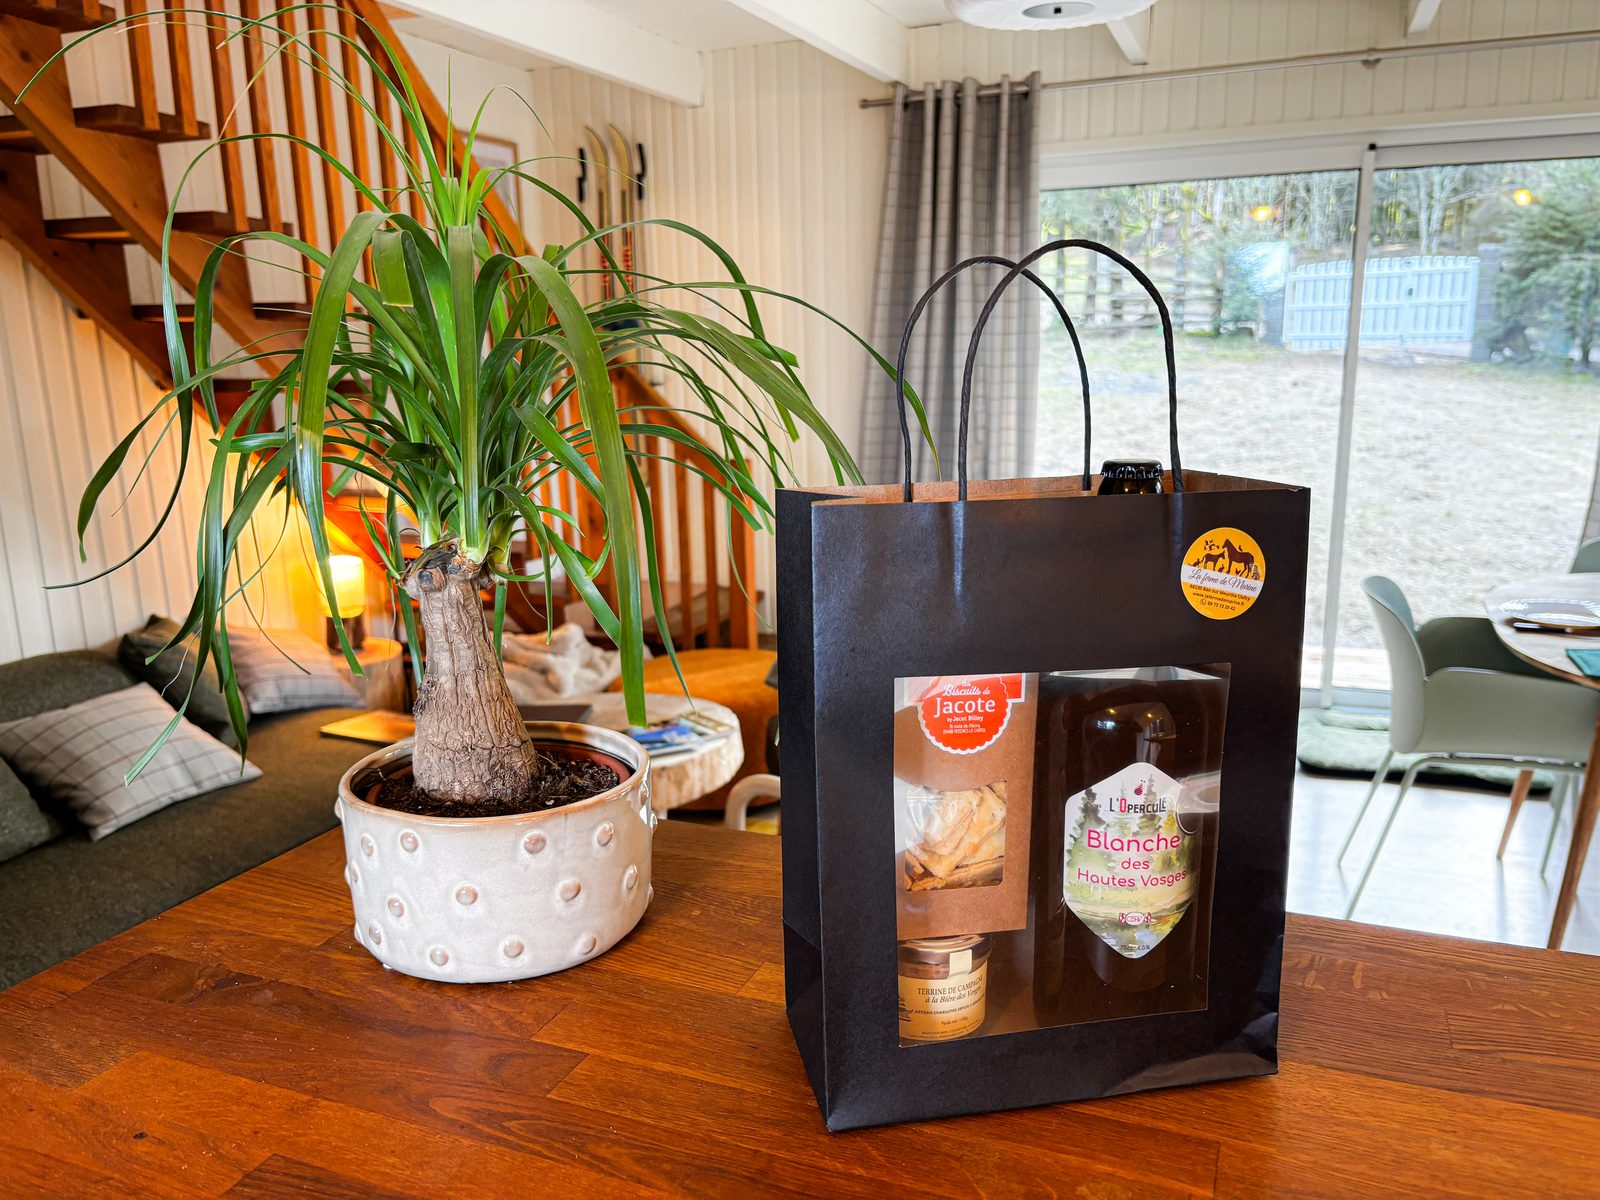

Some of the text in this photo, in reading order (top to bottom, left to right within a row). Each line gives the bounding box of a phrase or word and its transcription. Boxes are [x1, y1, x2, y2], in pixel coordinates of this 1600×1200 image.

[1219, 576, 1228, 585] de
[1228, 577, 1257, 592] Marine
[942, 684, 990, 696] Biscuits de
[933, 697, 996, 718] Jacote
[1109, 797, 1167, 814] L'OPERCULE
[1087, 829, 1181, 853] Blanche
[1121, 857, 1150, 870] des
[1077, 867, 1187, 888] Hautes Vosges
[917, 987, 948, 996] TERRINE
[948, 985, 957, 994] DE
